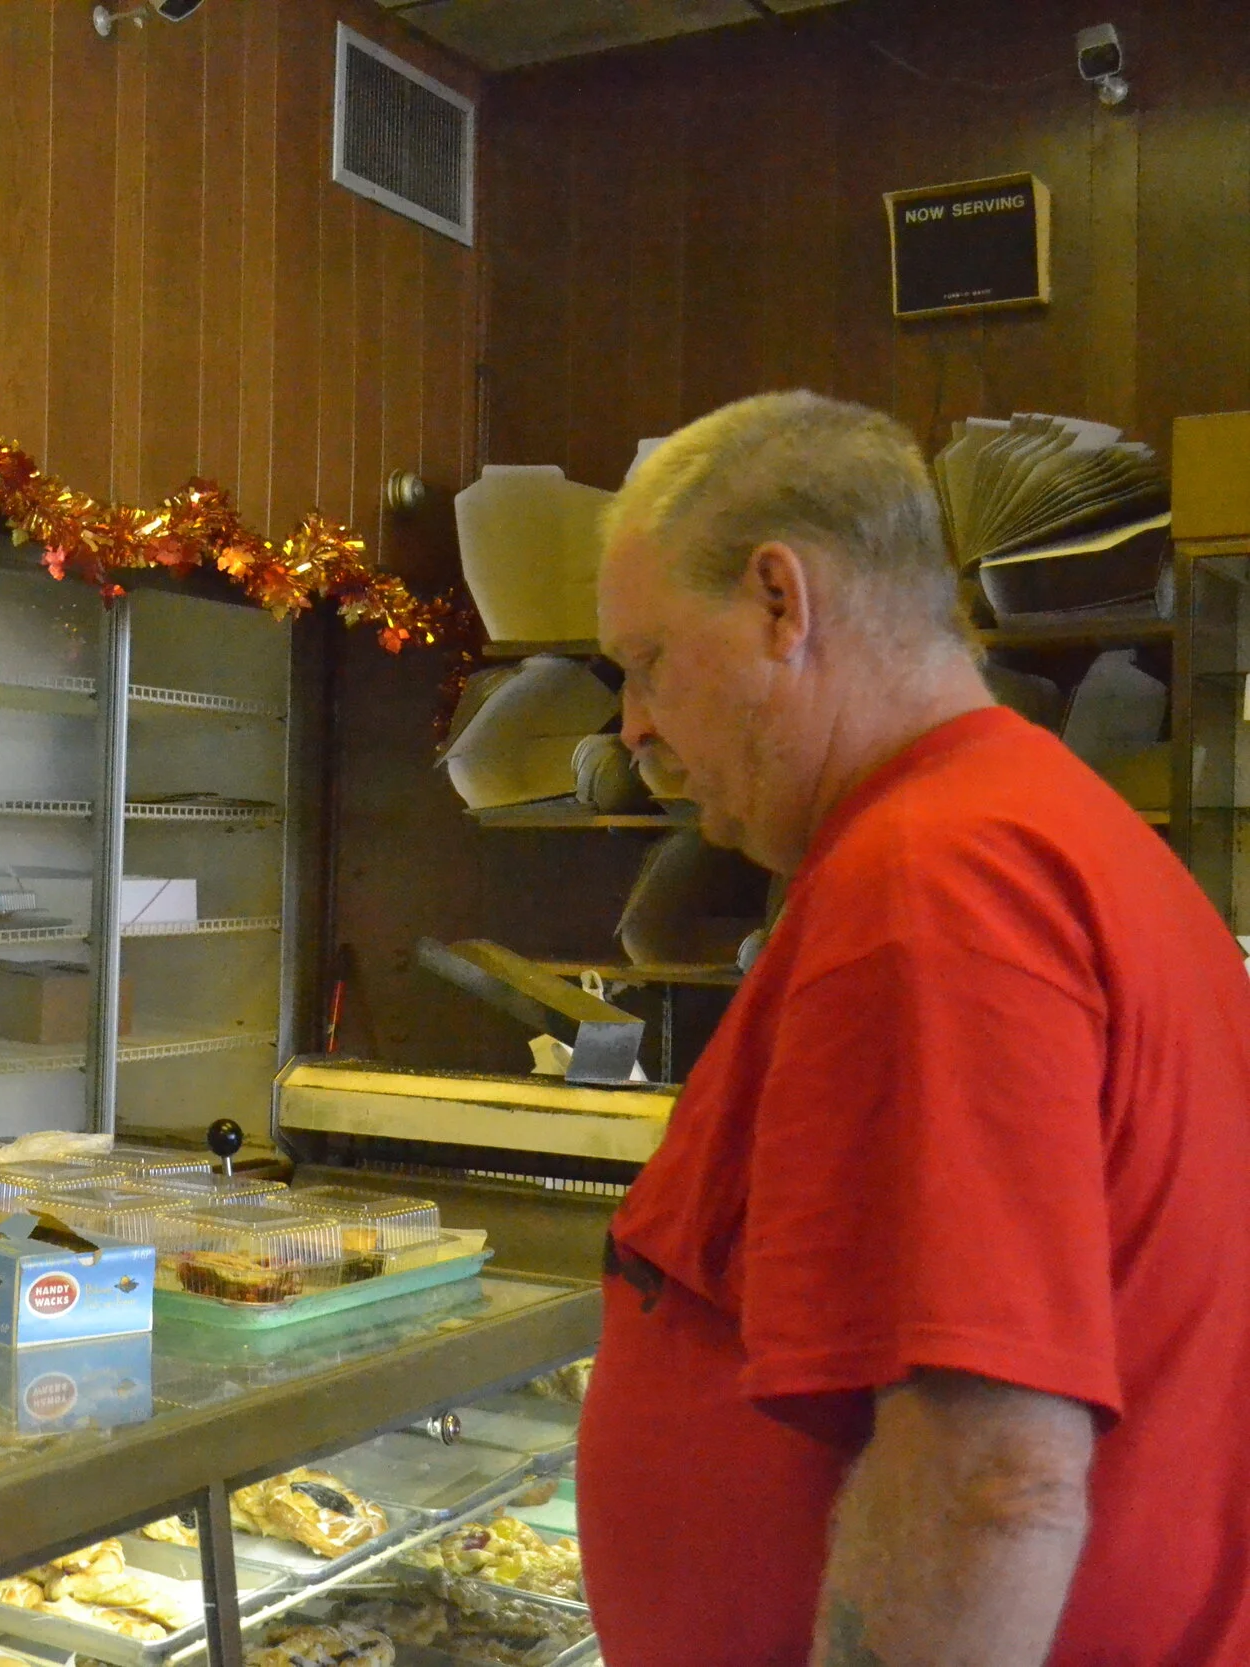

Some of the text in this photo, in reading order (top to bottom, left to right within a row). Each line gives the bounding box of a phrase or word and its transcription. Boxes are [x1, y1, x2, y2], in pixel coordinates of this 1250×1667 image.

[905, 195, 1025, 223] NOW SERVING
[36, 1284, 70, 1295] HANDY
[35, 1295, 70, 1307] WACKS
